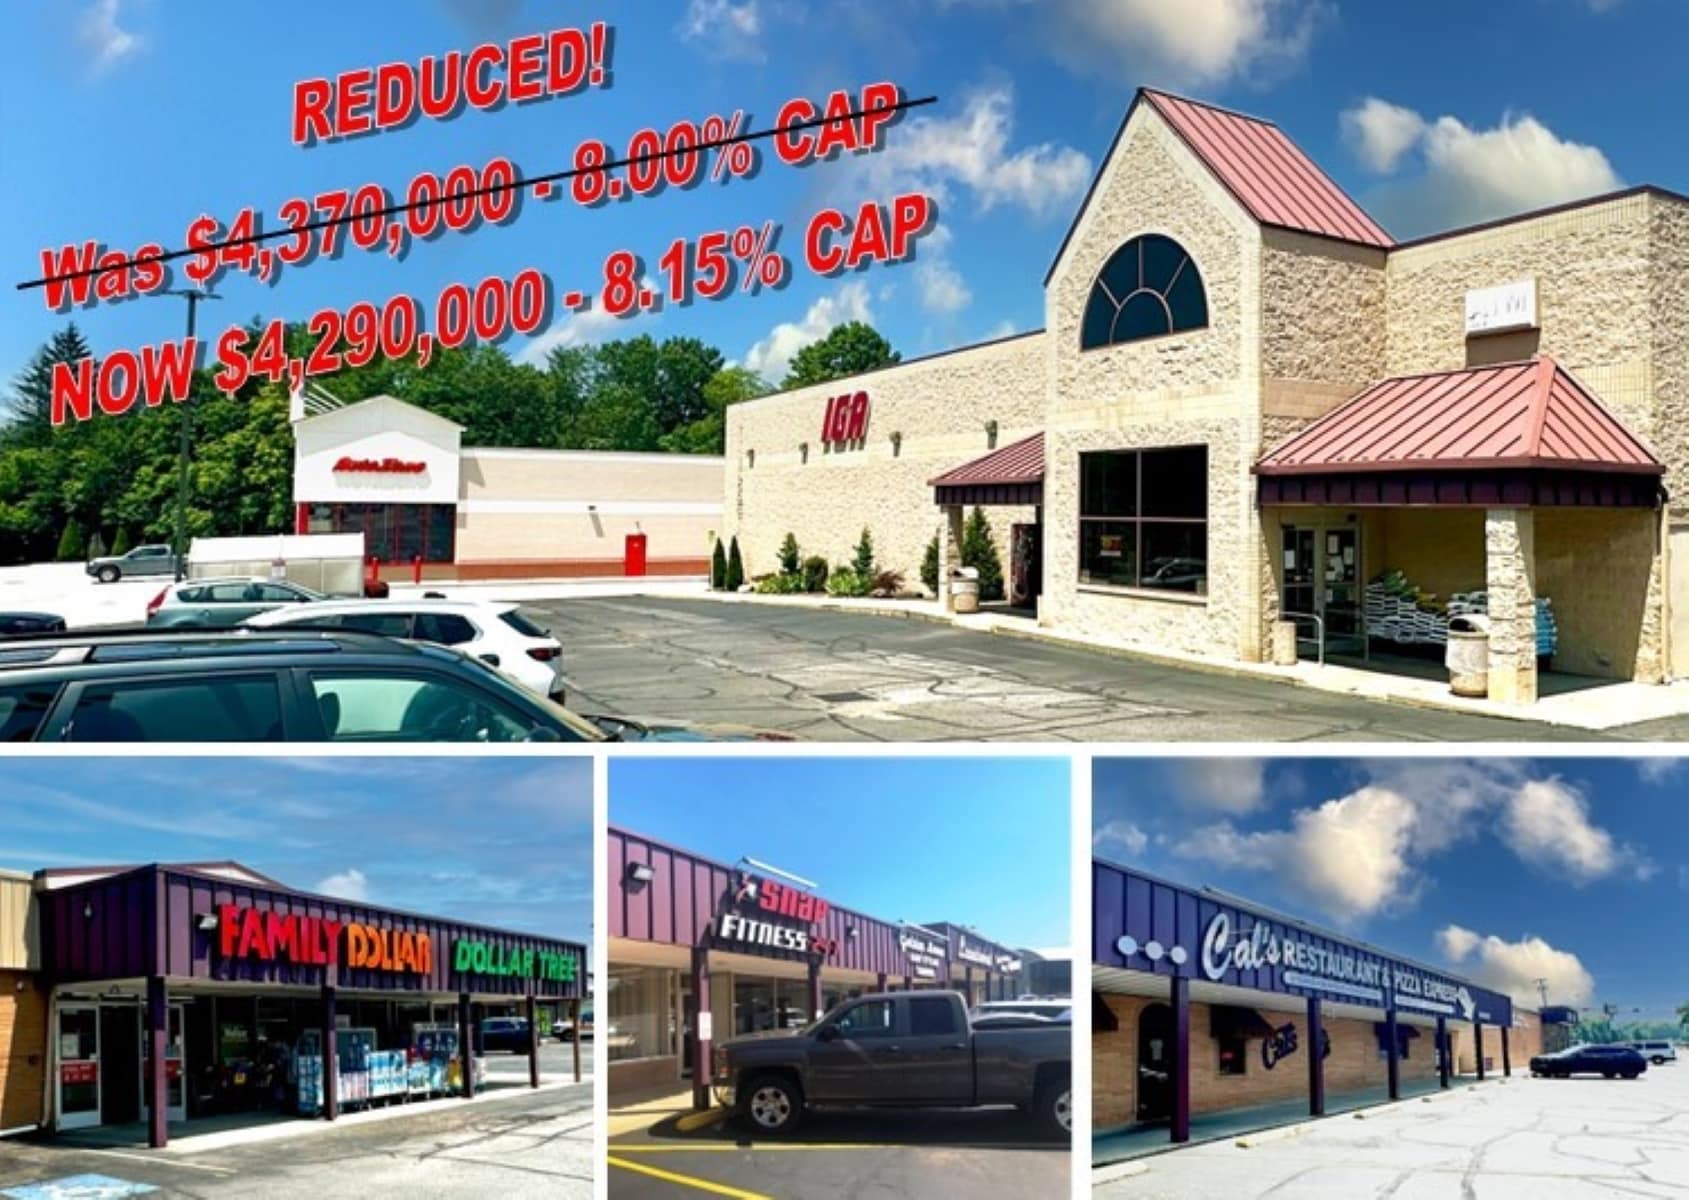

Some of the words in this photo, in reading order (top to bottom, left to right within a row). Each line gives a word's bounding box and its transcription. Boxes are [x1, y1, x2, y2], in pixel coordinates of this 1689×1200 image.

[821, 390, 870, 443] IGA
[219, 903, 342, 965] FAMILY
[347, 922, 432, 976] DOLLAR
[455, 939, 535, 977] DOLLAR
[538, 950, 577, 982] TREE
[1202, 912, 1281, 980] Cal's
[1283, 938, 1380, 986] RESTAURANT
